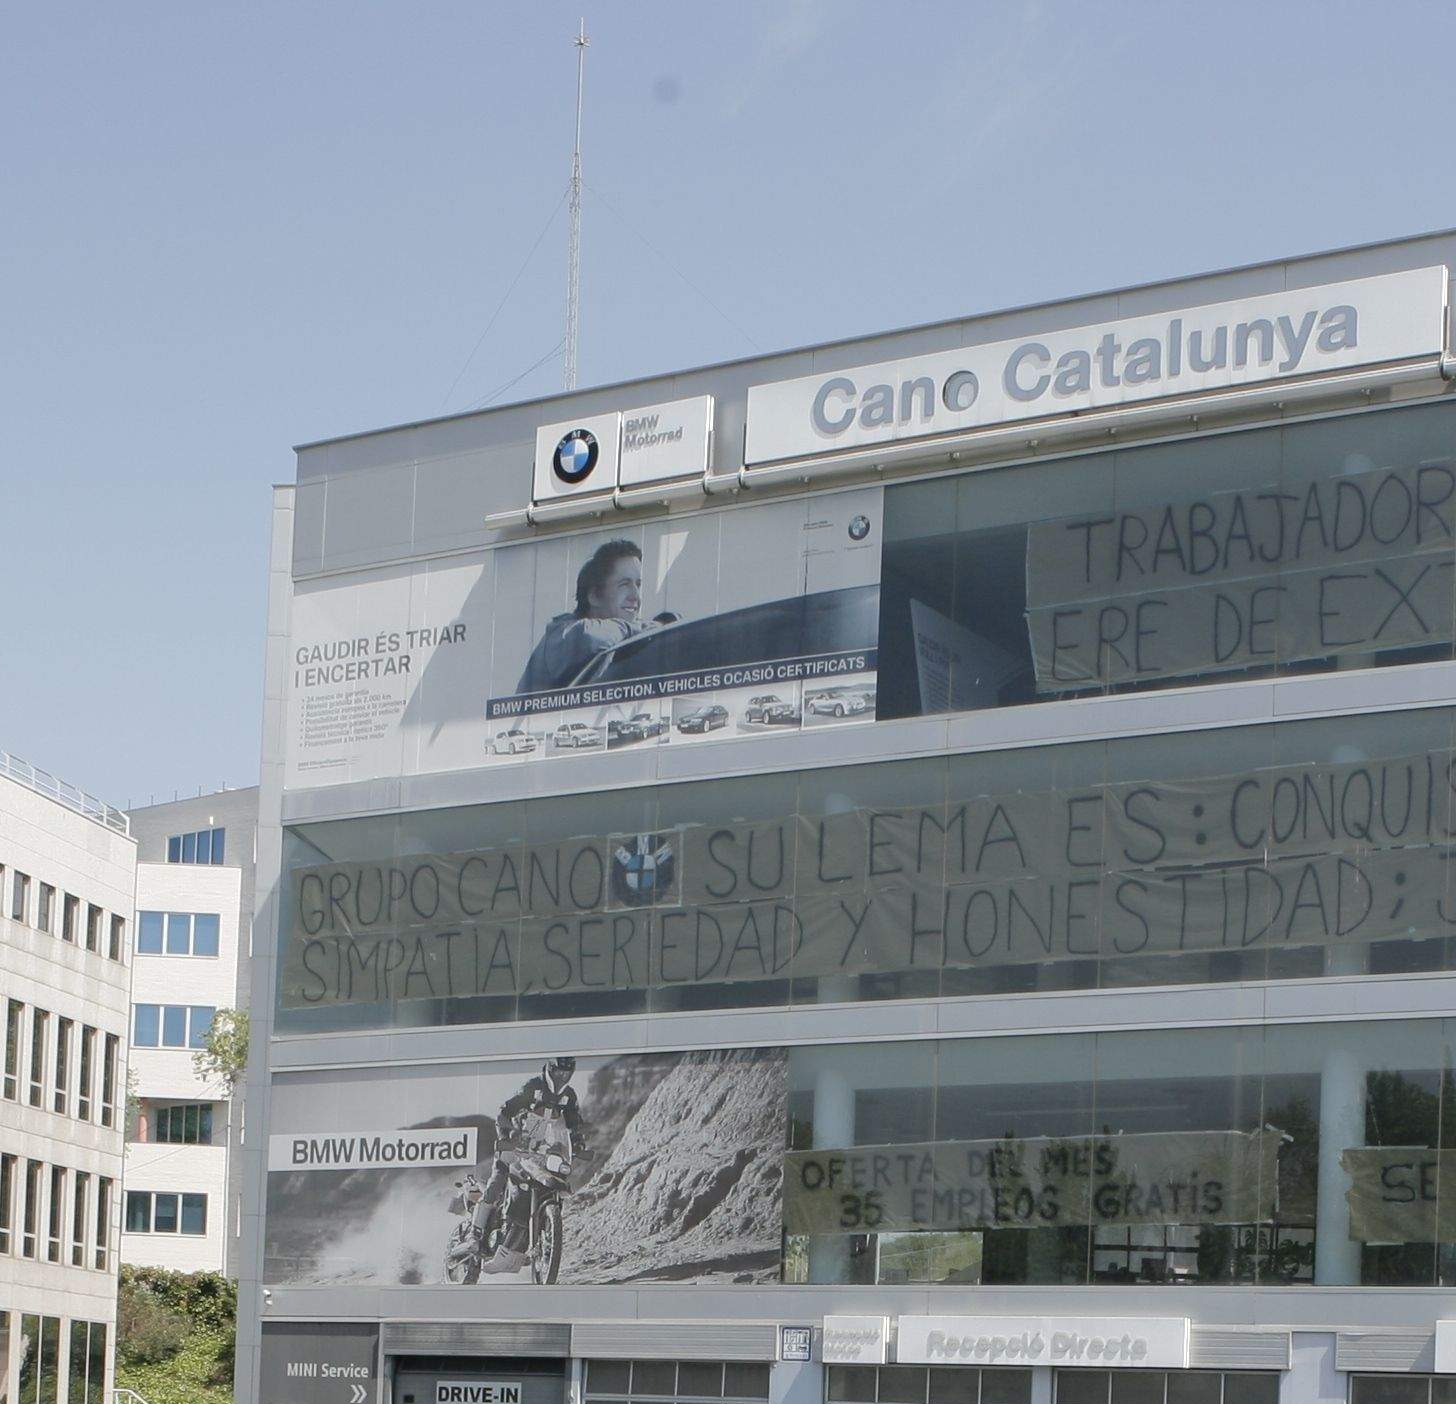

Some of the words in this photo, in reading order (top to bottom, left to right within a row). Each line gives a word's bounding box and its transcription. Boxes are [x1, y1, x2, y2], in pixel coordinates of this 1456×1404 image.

[812, 368, 980, 438] Cano
[1002, 303, 1360, 402] Catalunya
[623, 426, 683, 451] Motorrad
[626, 414, 660, 433] BMW
[296, 638, 370, 665] GAUDIR
[375, 631, 400, 654] ÉS
[406, 624, 467, 649] TRIAR
[1049, 595, 1162, 684] ERE
[1214, 588, 1279, 663] DE
[295, 671, 299, 688] I
[305, 655, 411, 687] ENCERTAR
[492, 702, 523, 716] BMW
[524, 692, 581, 711] PREMIUM
[584, 683, 656, 703] SELECTION.
[659, 674, 721, 694] VEHICLES
[724, 665, 774, 684] OCASIÓ
[777, 656, 866, 679] CERTIFICATS
[706, 828, 786, 898] SU
[817, 804, 1026, 885] LEMA
[301, 863, 440, 936] GRUPO
[456, 846, 604, 917] CANO
[839, 898, 872, 964] Y
[292, 1139, 355, 1164] BMW
[359, 1134, 468, 1162] Motorrad
[799, 1154, 941, 1191] OFERTA
[1044, 1146, 1119, 1177] MES
[910, 1183, 1060, 1222] EMPLEOS
[1092, 1170, 1224, 1217] GRATIS
[1380, 1162, 1438, 1204] SE
[927, 1330, 1044, 1361] Recepció
[1050, 1332, 1148, 1361] Directa
[286, 1363, 317, 1379] MINI
[321, 1363, 369, 1379] Service
[438, 1386, 519, 1404] DRIVE-IN
